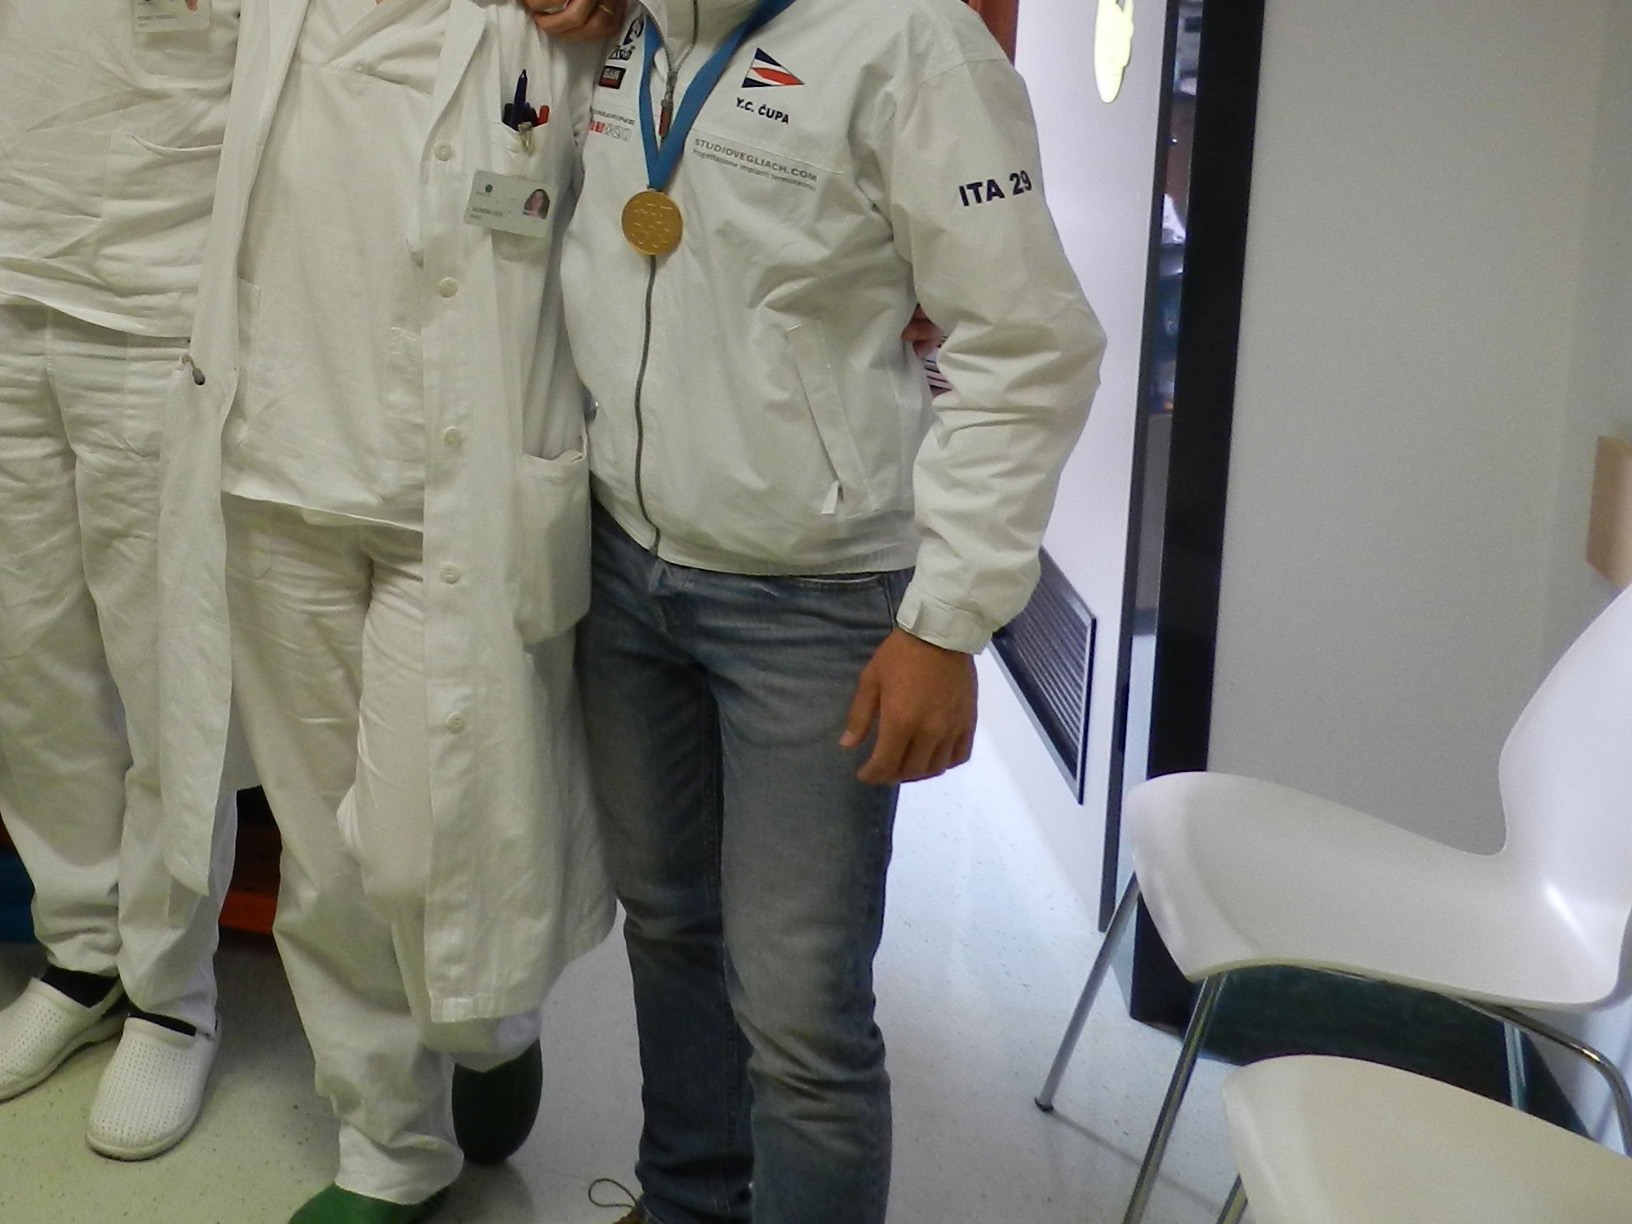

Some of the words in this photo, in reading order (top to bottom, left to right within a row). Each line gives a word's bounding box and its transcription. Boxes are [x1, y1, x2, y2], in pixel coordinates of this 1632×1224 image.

[735, 96, 755, 113] Y.C.
[695, 137, 818, 182] STUDIOVEGLIACH.COM
[958, 178, 1006, 207] ITA
[1009, 169, 1033, 196] 29
